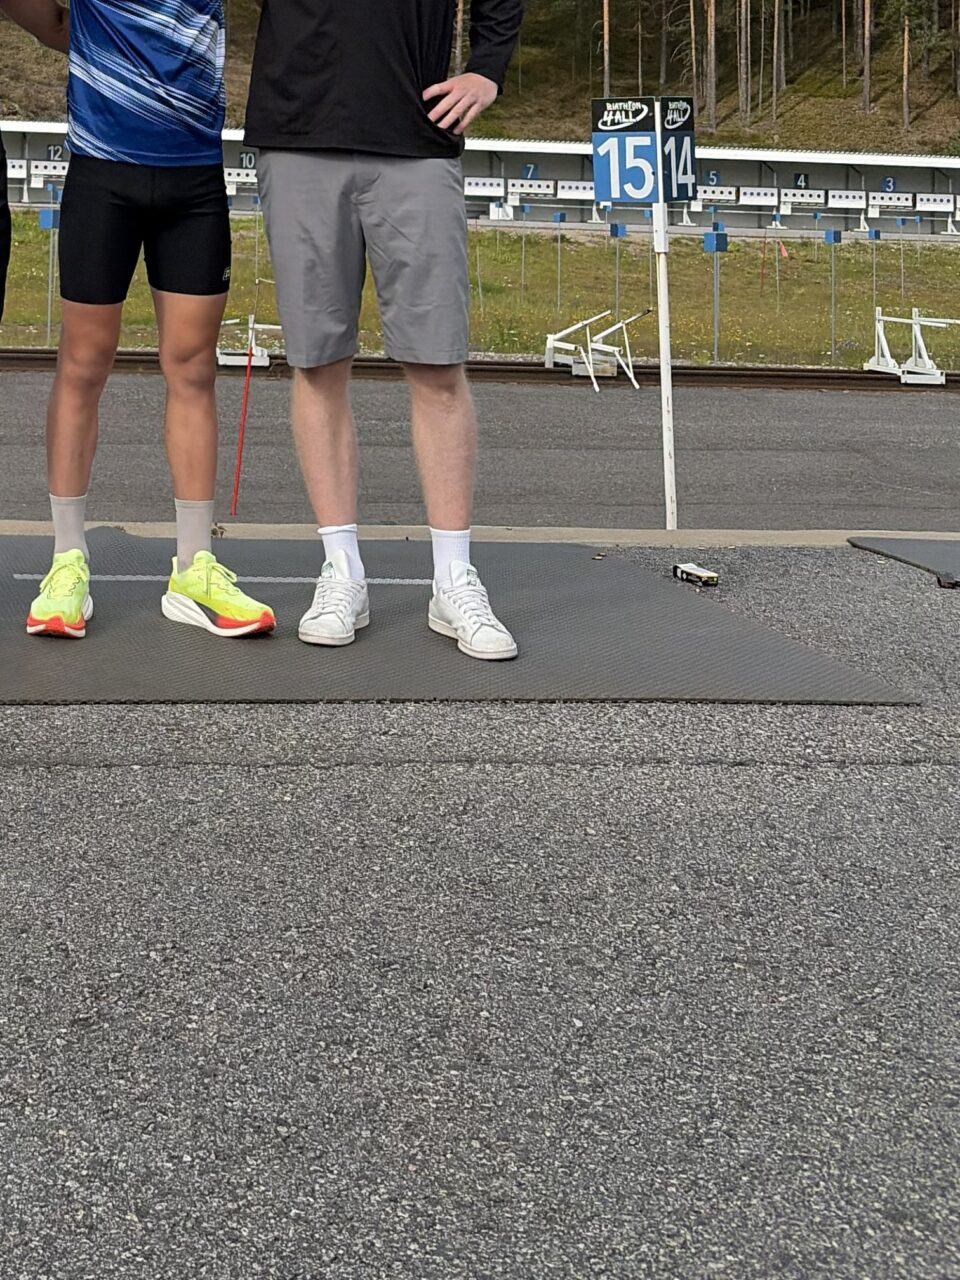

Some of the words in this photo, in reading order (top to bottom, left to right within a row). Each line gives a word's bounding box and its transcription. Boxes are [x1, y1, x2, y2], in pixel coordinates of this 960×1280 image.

[48, 145, 62, 160] 12
[240, 153, 255, 169] 10
[597, 136, 655, 199] 15
[663, 136, 696, 198] 14
[526, 164, 534, 179] 7
[709, 171, 717, 186] 5
[797, 174, 806, 189] 4
[886, 177, 894, 192] 3
